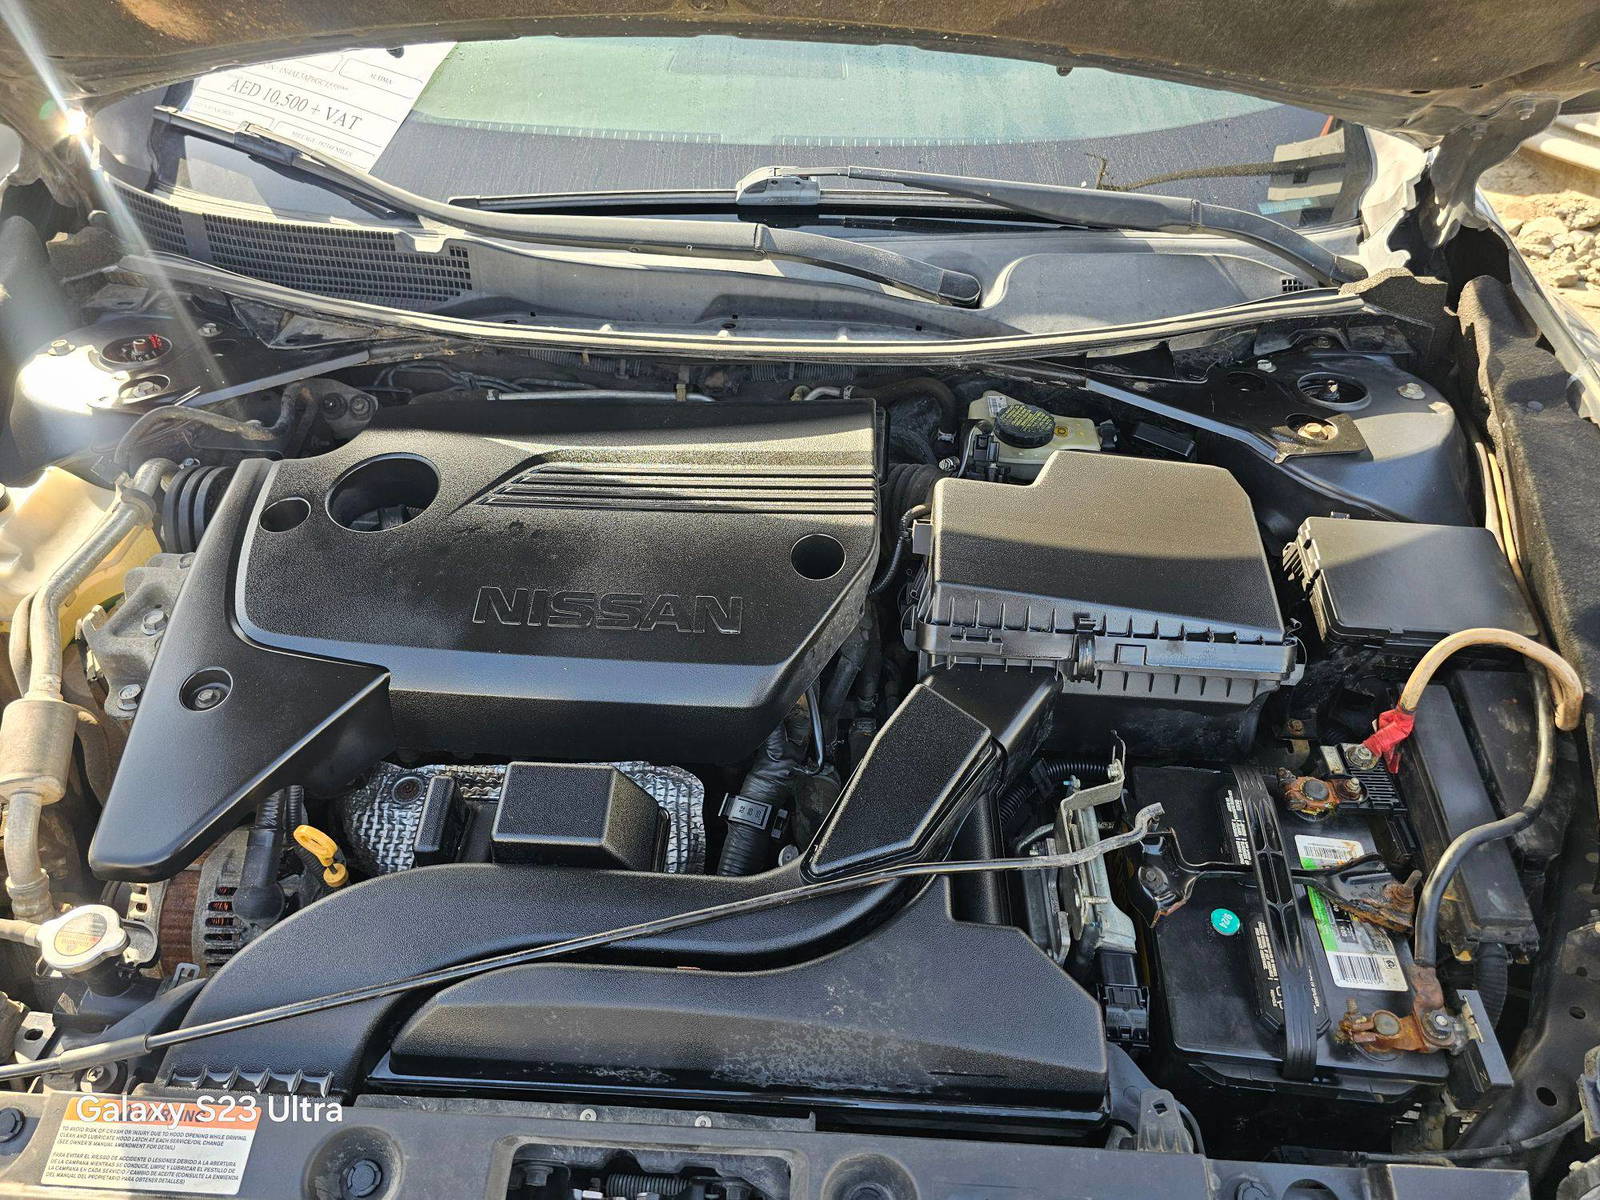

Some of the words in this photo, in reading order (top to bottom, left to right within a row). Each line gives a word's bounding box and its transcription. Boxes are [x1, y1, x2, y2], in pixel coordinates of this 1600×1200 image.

[227, 79, 261, 97] AED
[311, 103, 321, 116] +
[326, 106, 363, 131] VAT
[472, 586, 743, 635] NISSAN
